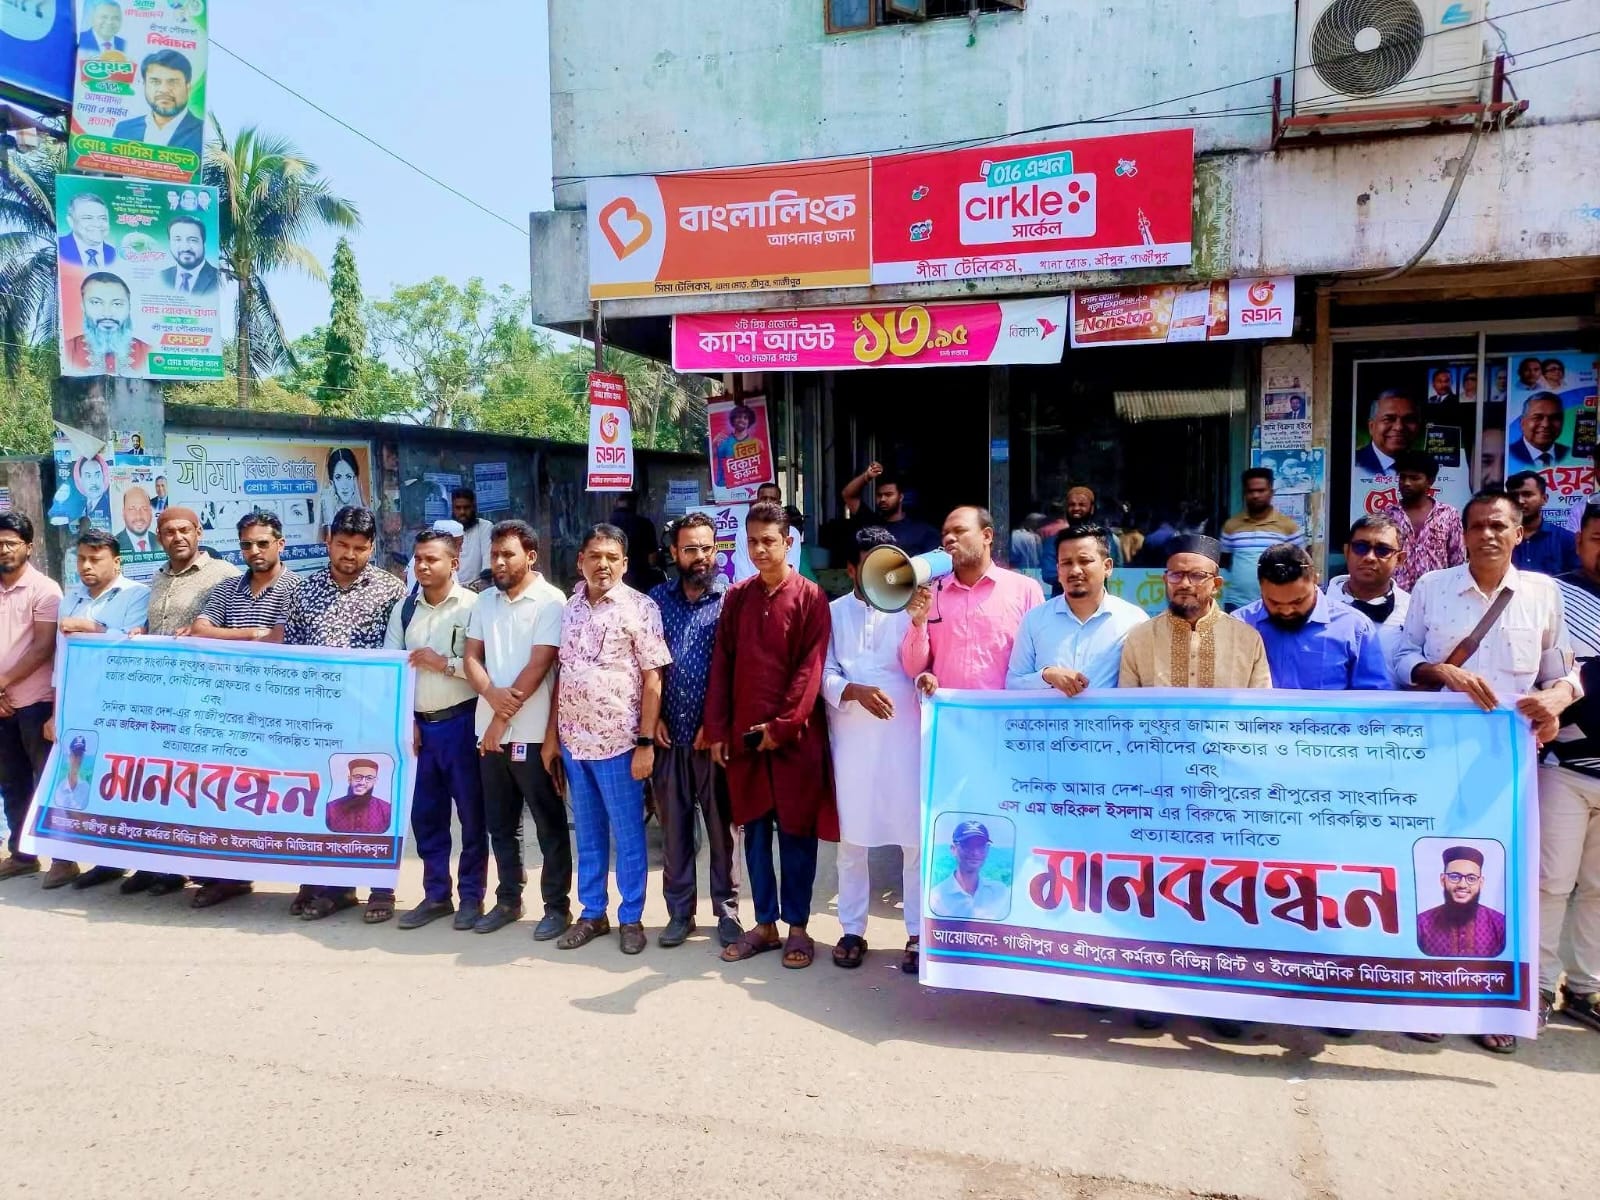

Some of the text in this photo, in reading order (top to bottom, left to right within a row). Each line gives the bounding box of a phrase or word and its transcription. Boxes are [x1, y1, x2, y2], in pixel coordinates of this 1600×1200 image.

[147, 32, 197, 49] নির্বাচনে
[83, 62, 133, 79] মেয়র
[78, 138, 106, 151] মোঃ
[111, 140, 153, 159] নাসিম
[1025, 157, 1065, 177] এখন
[679, 189, 856, 232] বাংলালিংক
[965, 184, 1062, 222] cirkle
[767, 229, 855, 246] আপনার জন্য
[1012, 218, 1062, 237] সার্কেল
[916, 258, 947, 279] সীমা
[954, 256, 1024, 276] টেলিকম,
[1040, 260, 1062, 269] থানা
[1130, 250, 1170, 265] গাজীপুর
[675, 280, 713, 292] টেলিকম,
[773, 277, 800, 288] গাজীপুর
[1082, 312, 1154, 333] Nonstop
[1241, 307, 1282, 323] নগদ
[699, 322, 836, 353] ক্যাশ আউট
[596, 446, 626, 464] নগদ
[736, 443, 757, 458] বিল
[172, 444, 317, 494] সীমা বিউটি পার্লার
[727, 455, 761, 473] বিকাশ
[733, 466, 759, 480] করুন
[271, 480, 292, 492] সীমা
[1558, 495, 1583, 505] পদে
[144, 655, 178, 669] সাংবাদিক
[302, 668, 318, 682] গুলি
[321, 671, 342, 682] করে
[214, 678, 250, 692] গ্রেফতার
[255, 683, 262, 692] ও
[266, 681, 301, 696] বিচারের
[304, 683, 343, 699] দাবীতে
[201, 694, 222, 705] এবং
[194, 708, 244, 725] গাজীপুরের
[246, 712, 282, 729] শ্রীপুরের
[285, 718, 335, 733] সাংবাদিক
[1005, 716, 1424, 738] নেত্রকোনার সাংবাদিক লুৎফুর জামান আলিফ ফকিরকে গুলি করে
[119, 718, 148, 732] জহিরুল
[149, 720, 178, 735] ইসলাম
[178, 724, 191, 735] এর
[228, 728, 265, 743] সাজানো
[314, 737, 344, 750] মামলা
[162, 739, 249, 757] প্রত্যাহারের দাবিতে
[1005, 736, 1428, 762] হত্যার প্রতিবাদে, দোষীদের গ্রেফতার ও বিচারের দাবীতে
[1185, 762, 1219, 778] এবং
[99, 753, 321, 818] মানববন্ধন
[1012, 777, 1418, 807] দৈনিক আমার দেশ-এর গাজীপুরের শ্রীপুরের সাংবাদিক
[998, 799, 1437, 832] এস এম জহিরুল ইসলাম এর বিরুদ্ধে সাজানো পরিকল্পিত মামলা
[109, 826, 116, 834] ও
[117, 822, 142, 840] শ্রীপুরে
[144, 826, 171, 842] কর্মরত
[220, 837, 229, 847] ও
[286, 837, 323, 852] মিডিয়ার
[326, 839, 390, 859] সাংবাদিকবৃন্দ
[1130, 827, 1281, 848] প্রত্যাহারের দাবিতে
[1028, 847, 1400, 935] মানববন্ধন
[930, 927, 1507, 994] আয়োজনে: গাজীপুর ও শ্রীপুরে কর্মরত বিভিন্ন প্রিন্ট ও ইলেকট্রনিক মিডিয়ার সাংবাদিকবৃন্দ
